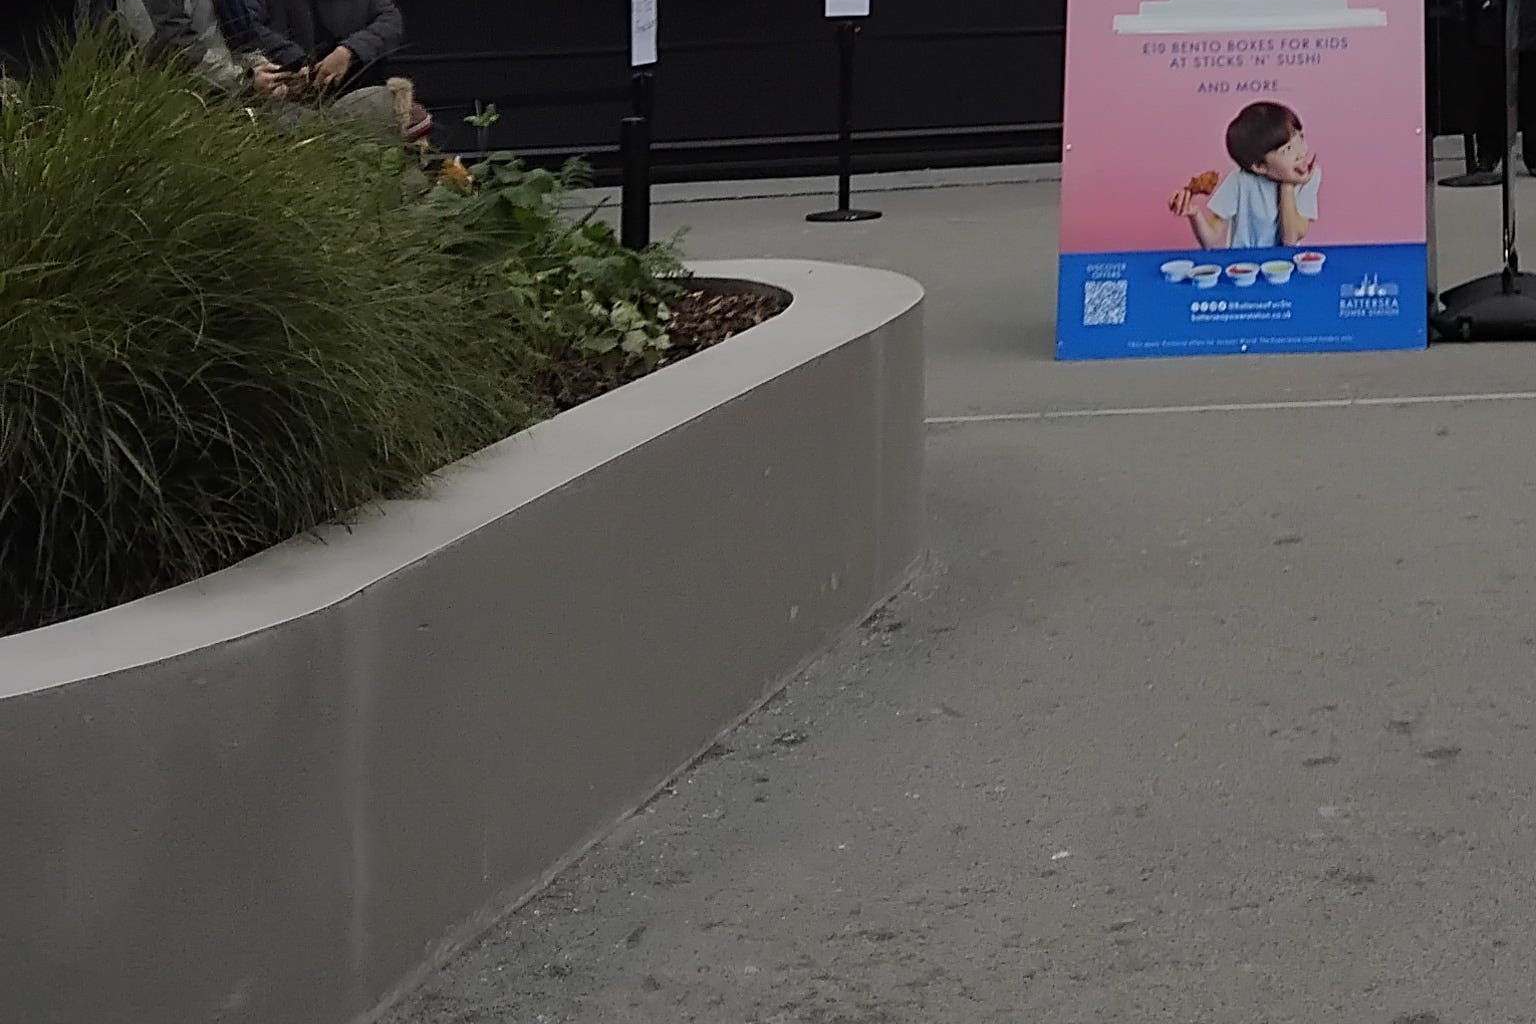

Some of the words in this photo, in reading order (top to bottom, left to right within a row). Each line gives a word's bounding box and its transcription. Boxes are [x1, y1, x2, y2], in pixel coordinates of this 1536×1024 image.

[1171, 40, 1222, 53] BENTO
[1227, 38, 1275, 52] BOXES
[1280, 37, 1310, 51] FOR
[1315, 36, 1349, 50] KIDS
[1169, 57, 1188, 69] AT
[1194, 55, 1244, 69] STICKS
[1277, 52, 1322, 66] SUSHI
[1198, 81, 1231, 94] AND
